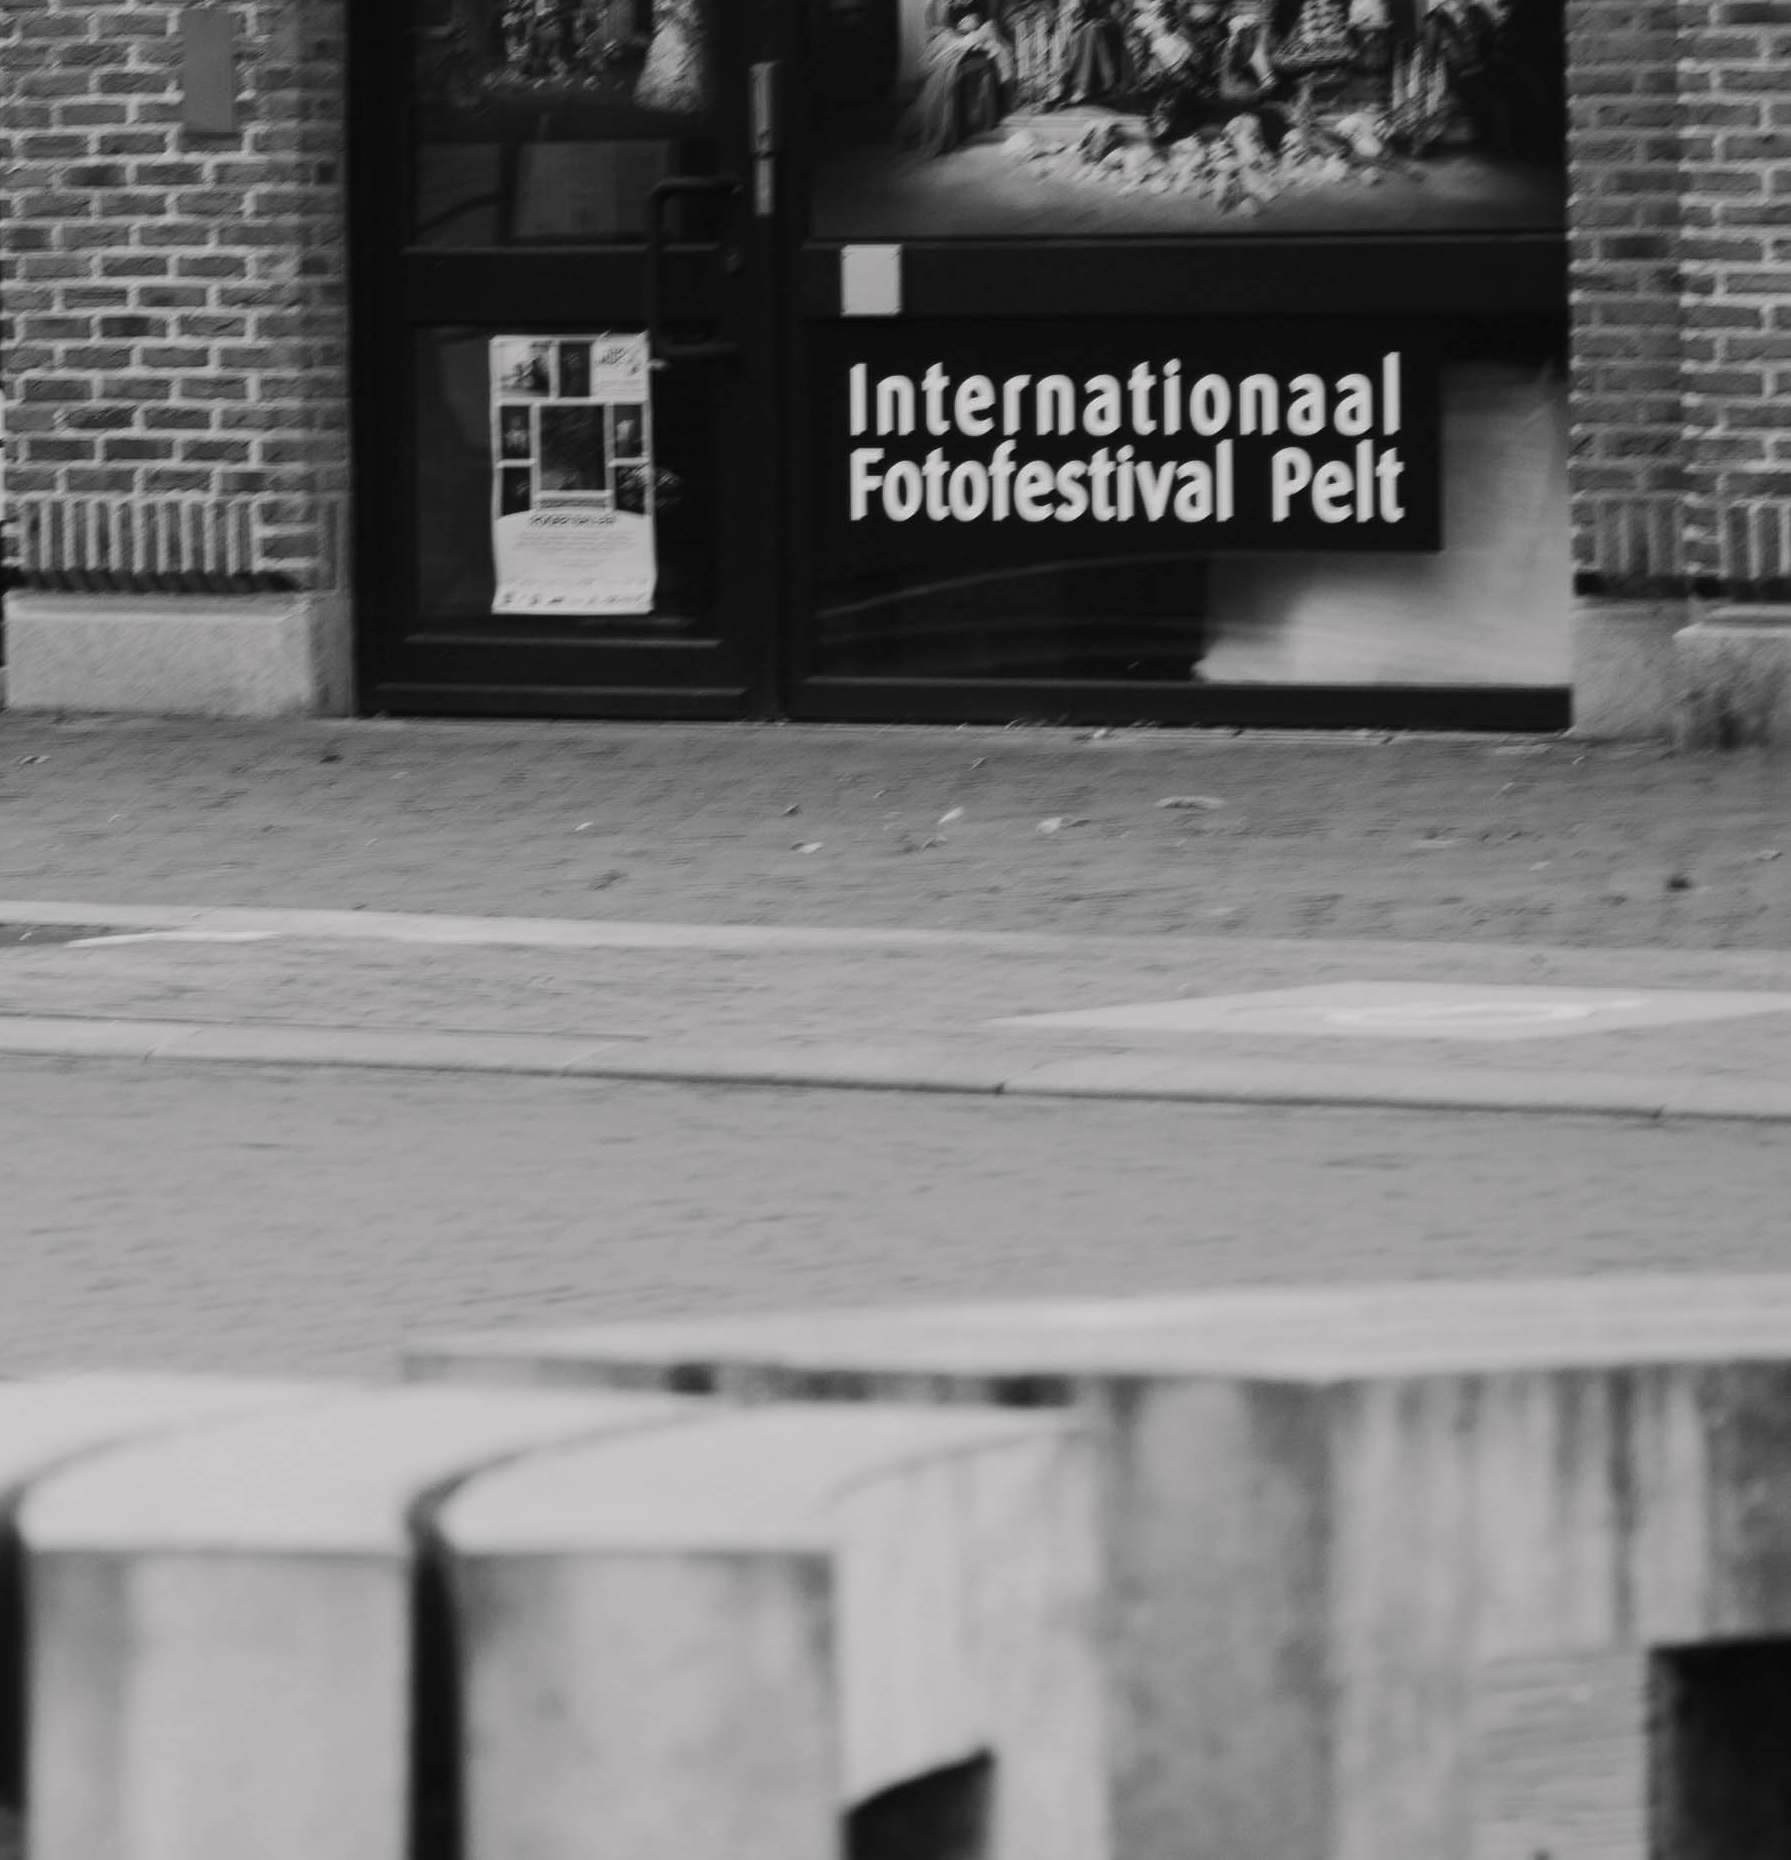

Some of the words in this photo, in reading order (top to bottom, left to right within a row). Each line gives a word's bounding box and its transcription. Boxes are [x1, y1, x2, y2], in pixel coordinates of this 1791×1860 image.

[849, 351, 1401, 437] Internationaal
[849, 438, 1234, 523] Fotofestival
[1271, 438, 1405, 524] Pelt
